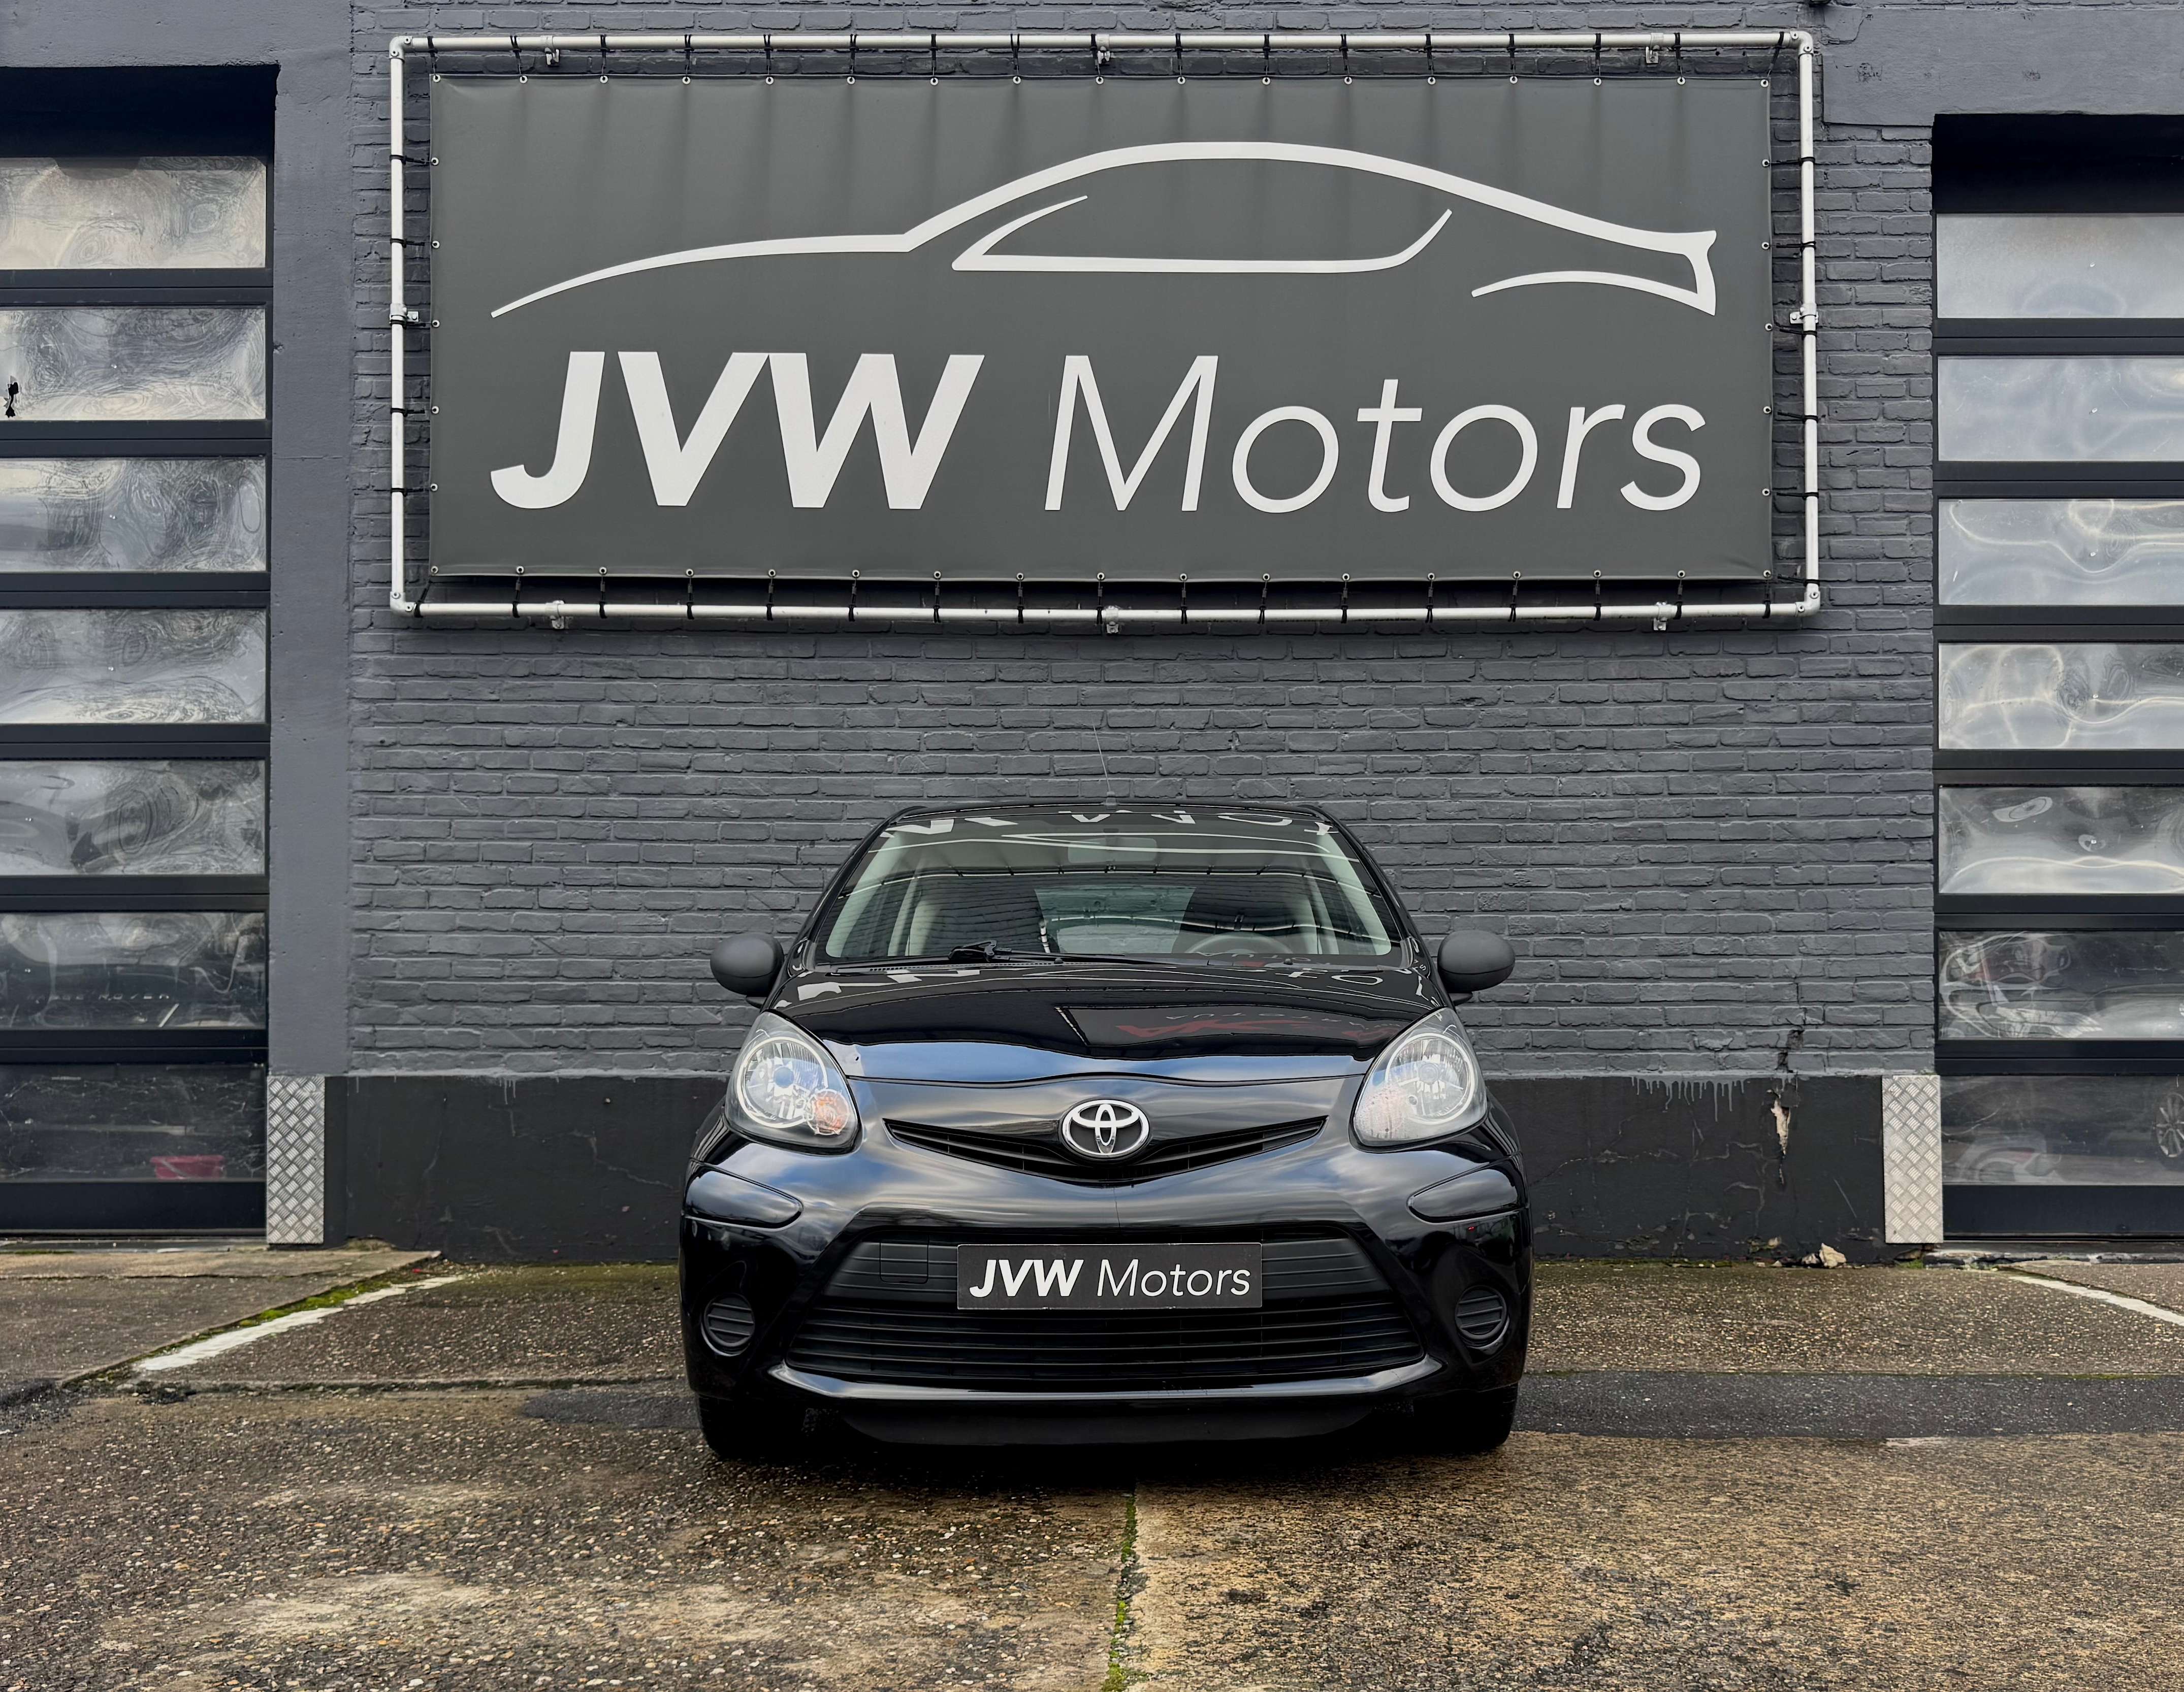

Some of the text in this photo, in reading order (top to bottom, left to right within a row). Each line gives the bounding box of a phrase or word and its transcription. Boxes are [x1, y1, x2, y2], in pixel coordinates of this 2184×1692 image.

[490, 350, 1706, 514] JVW Motors
[969, 1258, 1251, 1298] JVW Motors
